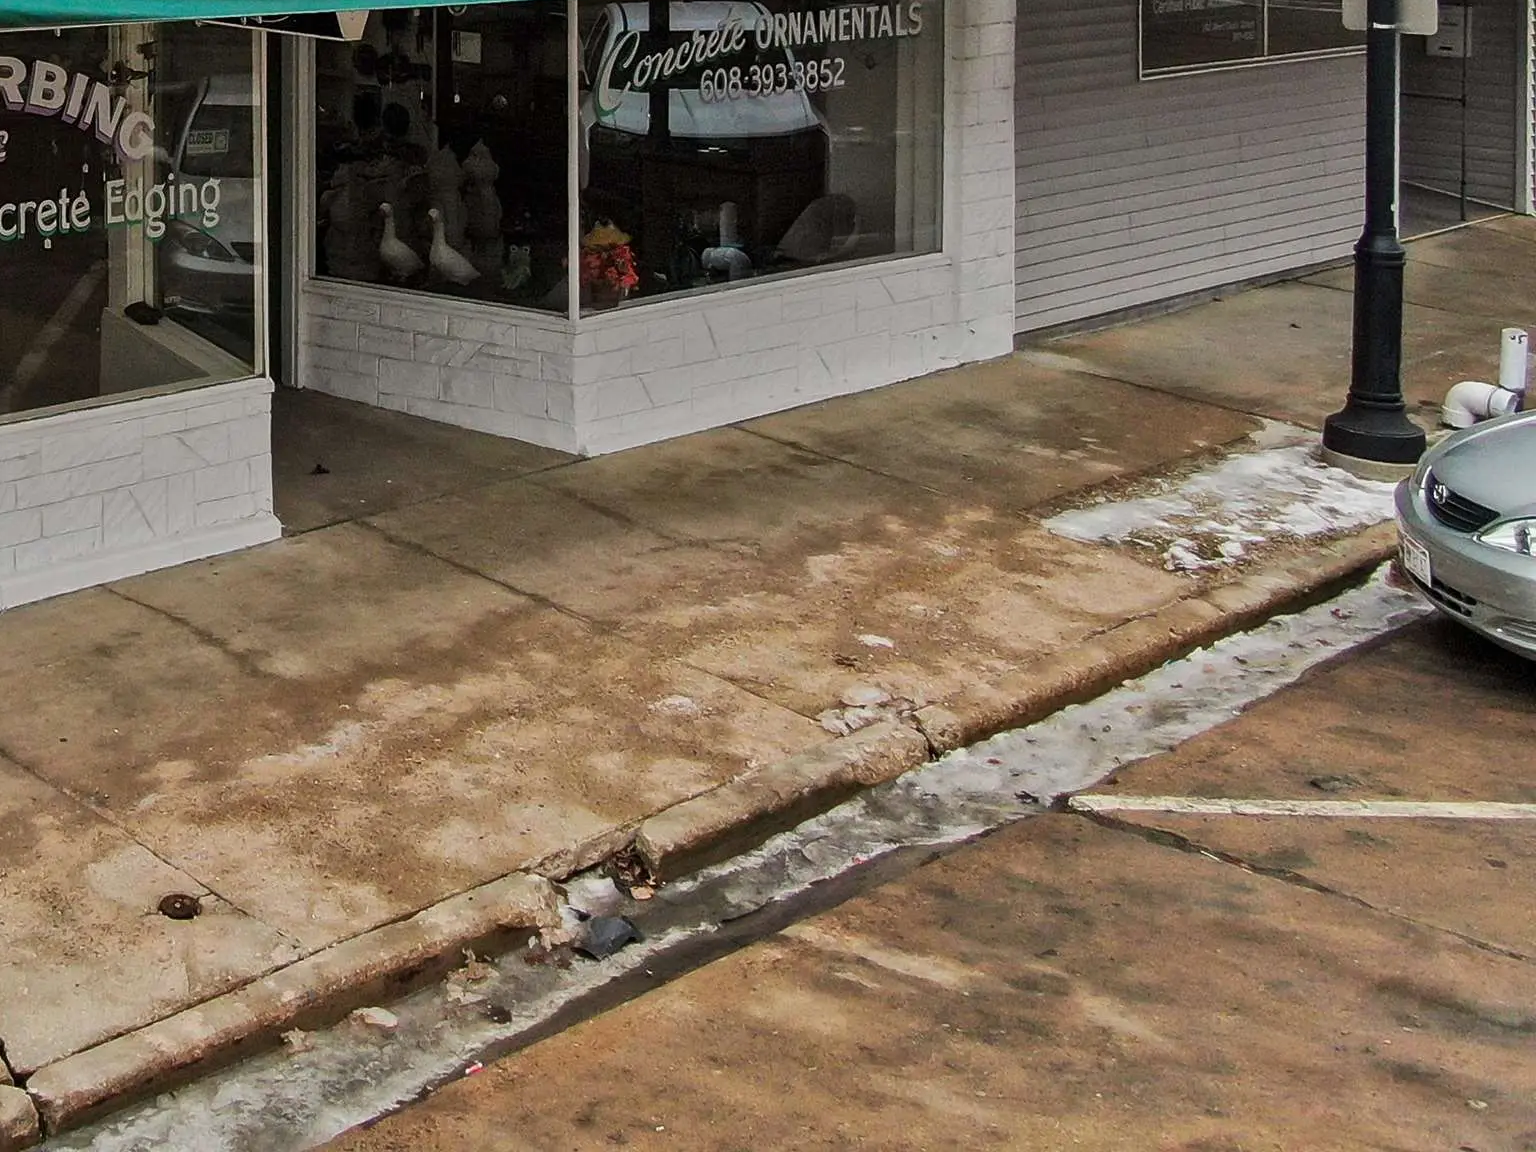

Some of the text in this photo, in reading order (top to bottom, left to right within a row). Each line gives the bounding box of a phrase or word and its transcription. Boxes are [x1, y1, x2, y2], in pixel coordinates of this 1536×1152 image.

[596, 2, 923, 118] Concrete ORNAMENTALS
[104, 173, 222, 239] Edging
